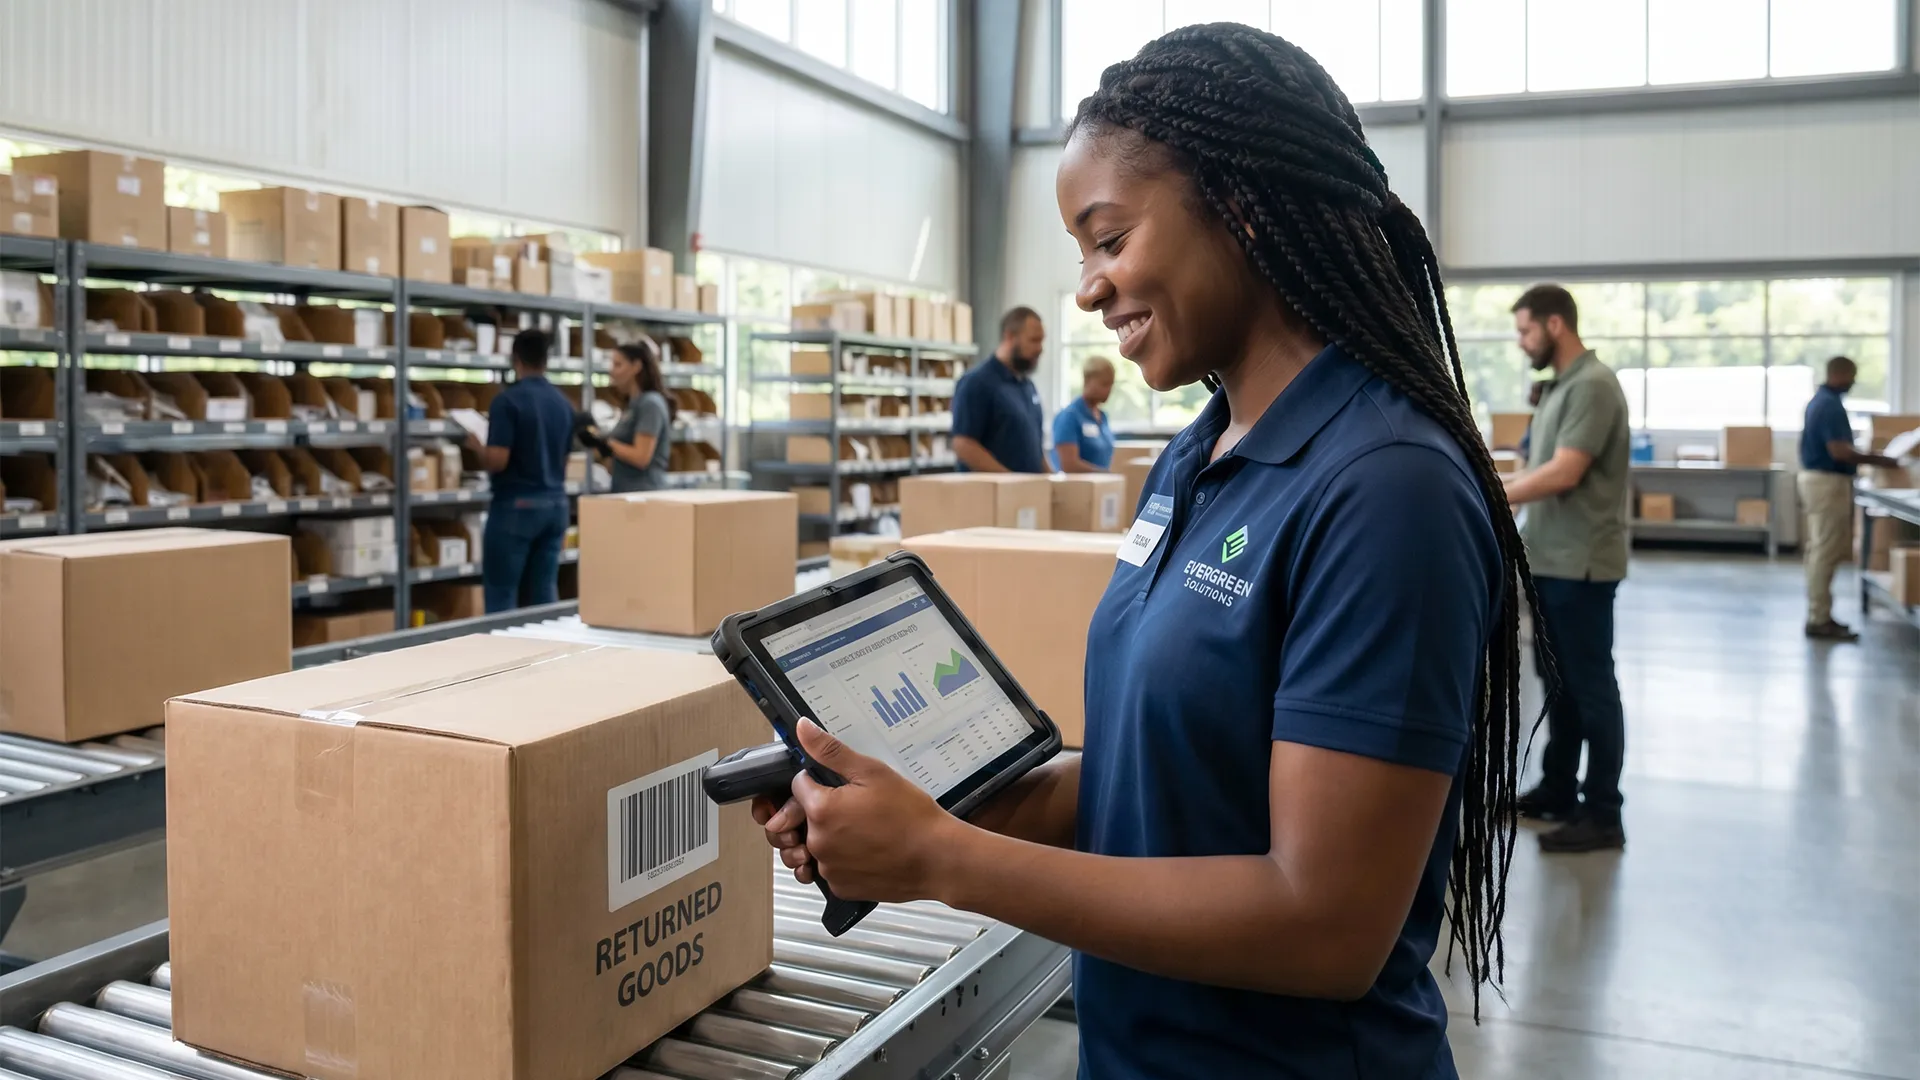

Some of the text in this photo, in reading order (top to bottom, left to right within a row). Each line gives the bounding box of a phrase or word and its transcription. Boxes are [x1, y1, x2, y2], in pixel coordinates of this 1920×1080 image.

[1183, 560, 1253, 598] EVERGREEN
[1183, 577, 1234, 607] SOLUTIONS
[596, 881, 722, 975] RETURNED
[618, 932, 705, 1007] GOODS
